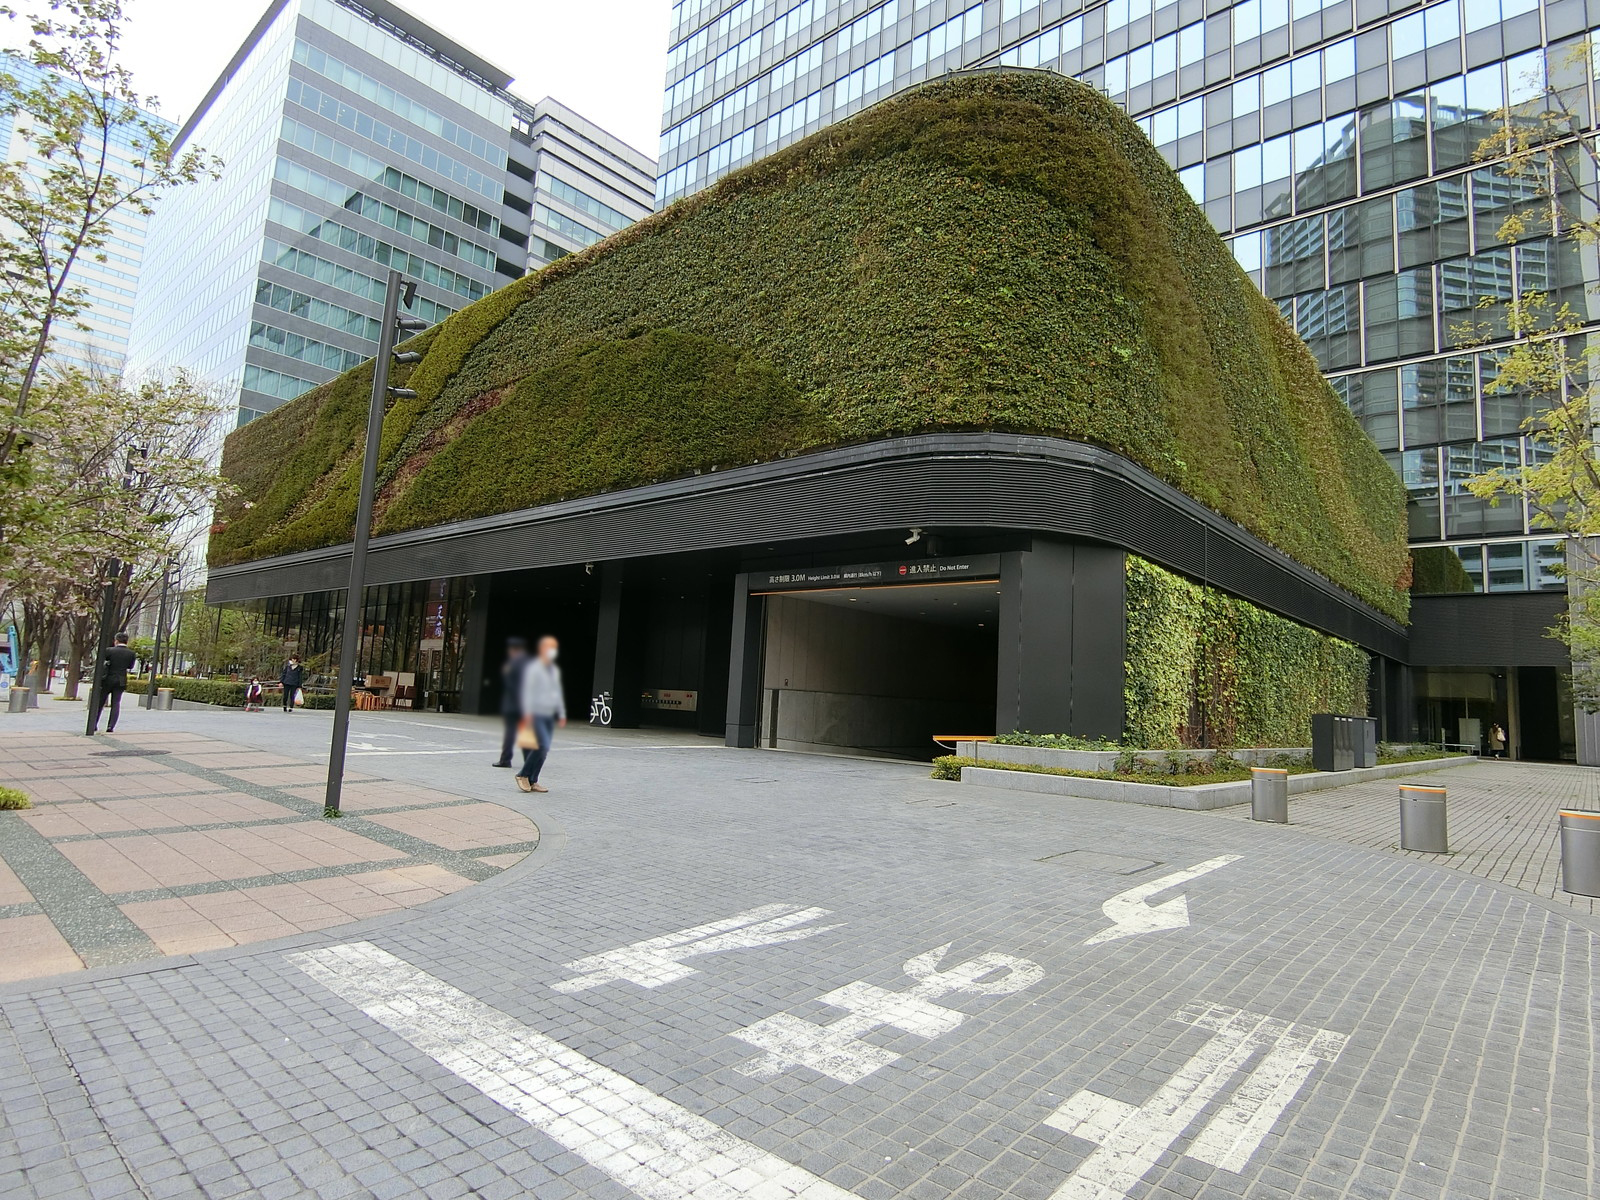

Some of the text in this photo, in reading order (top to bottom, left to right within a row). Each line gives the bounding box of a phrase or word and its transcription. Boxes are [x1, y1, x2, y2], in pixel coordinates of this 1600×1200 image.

[909, 564, 937, 574] 進入禁止
[768, 574, 806, 584] 高さ制限 3.0M
[550, 903, 1351, 1200] 止まれ
